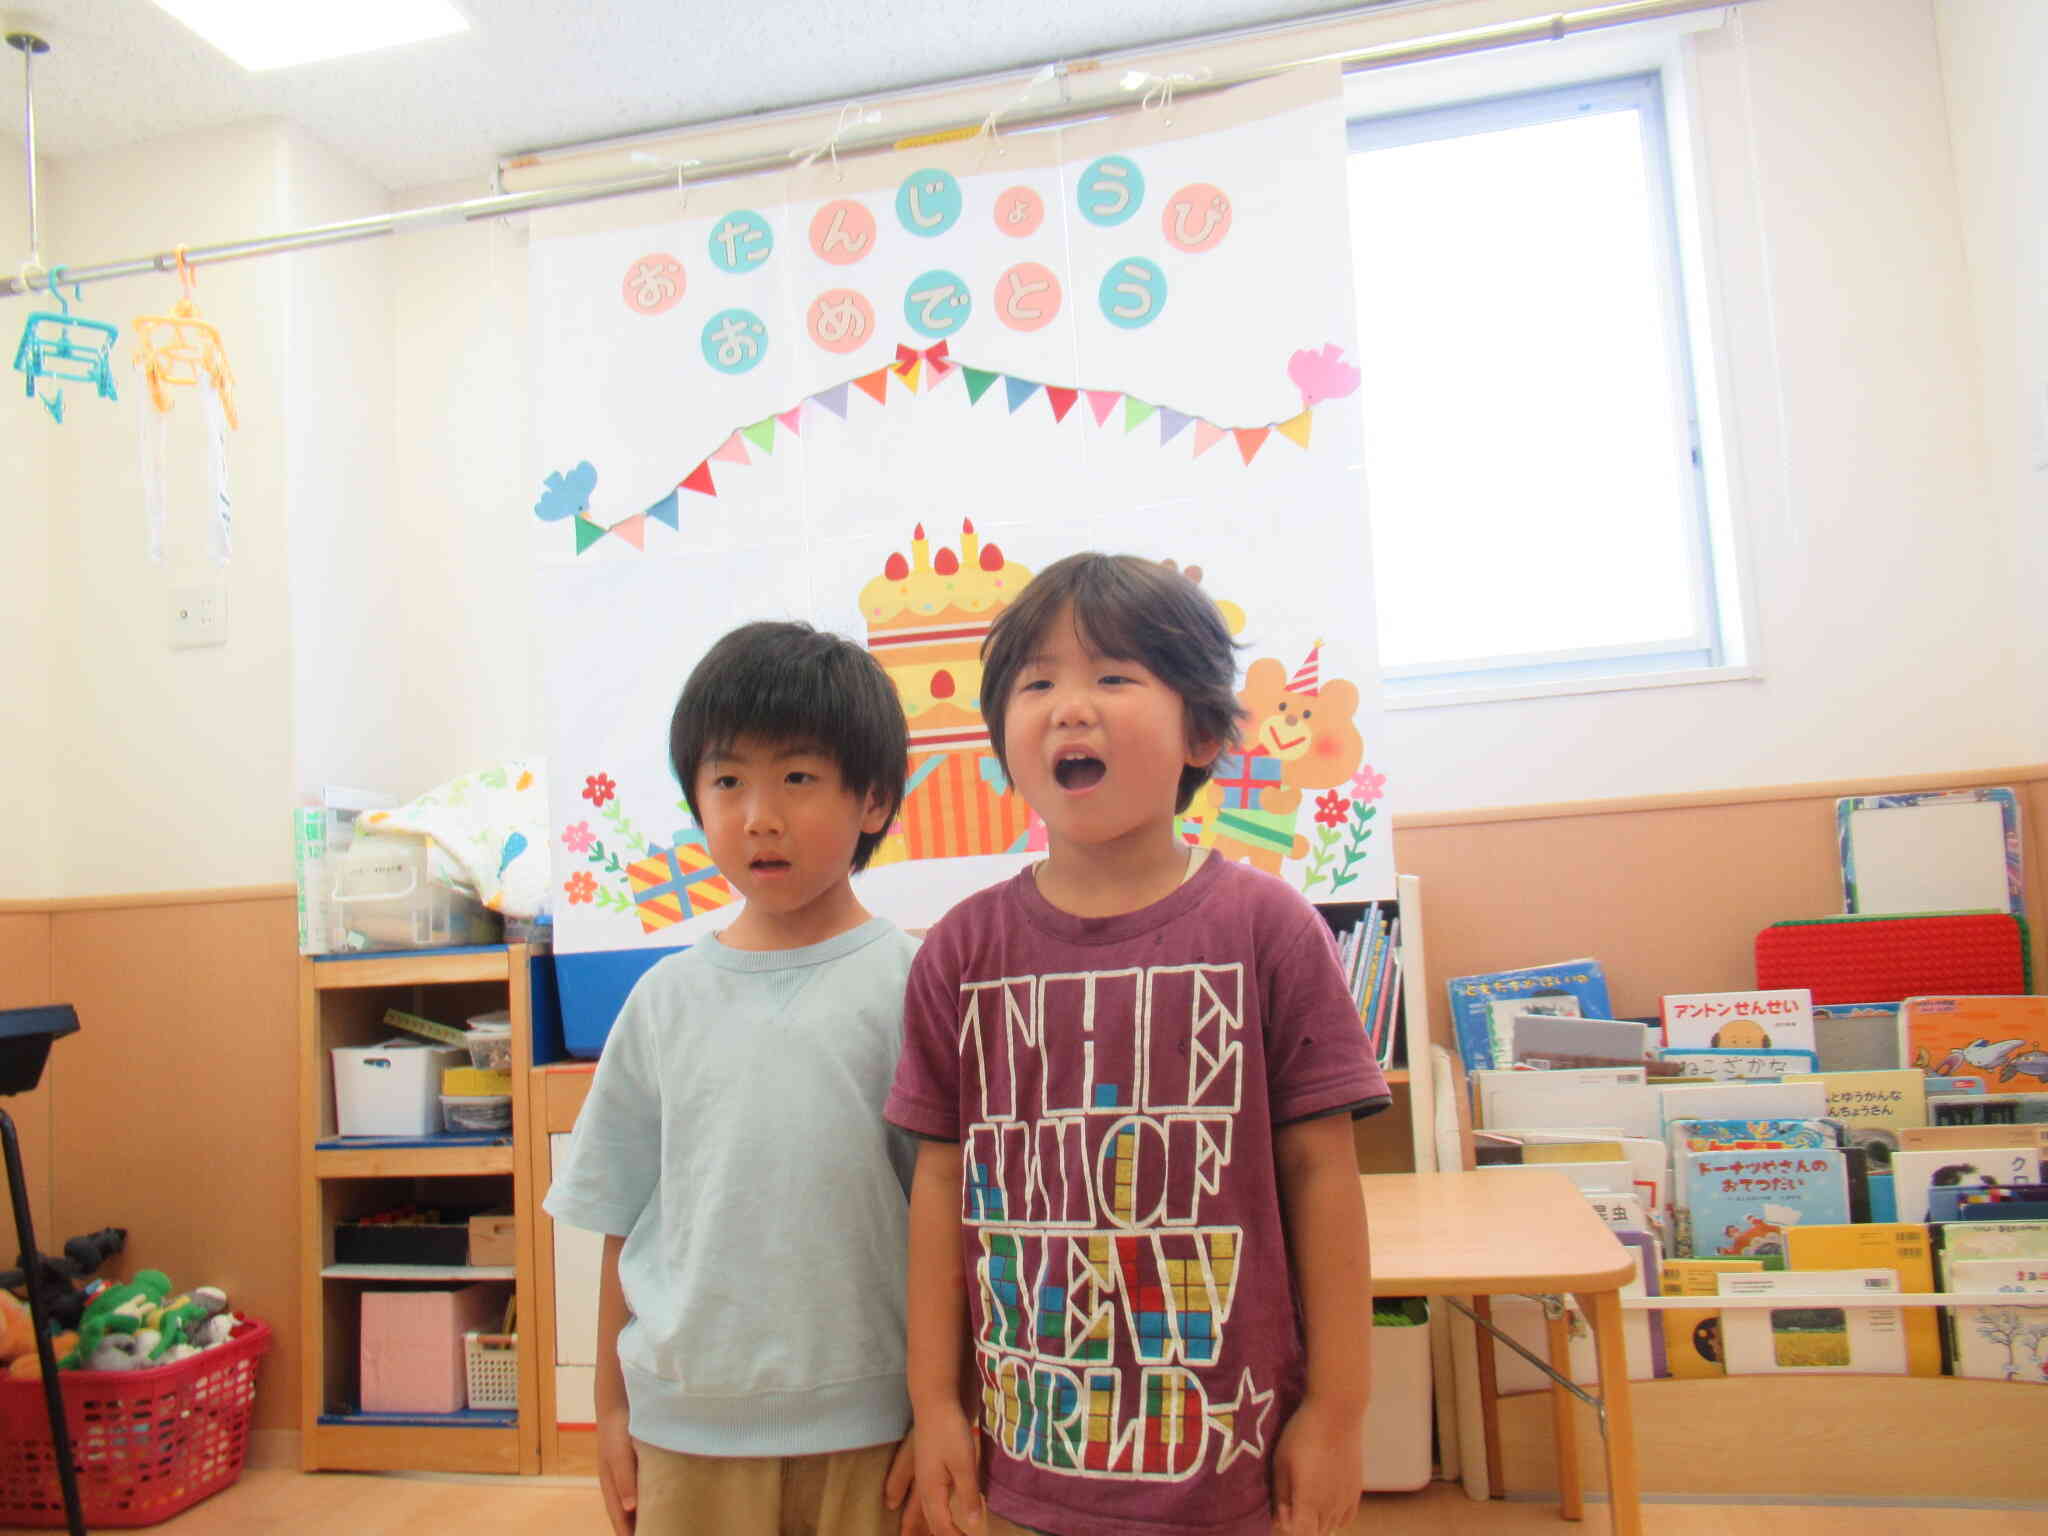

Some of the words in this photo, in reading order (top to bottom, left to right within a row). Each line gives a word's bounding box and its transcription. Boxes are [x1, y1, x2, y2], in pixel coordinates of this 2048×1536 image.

[627, 163, 1230, 307] おたんじょうび
[711, 264, 1153, 365] おめでとう
[959, 962, 1243, 1121] THE
[1673, 999, 1799, 1017] アントンせんせい
[1682, 1057, 1786, 1075] ねこざかな
[1096, 1114, 1233, 1229] OF
[1696, 1159, 1828, 1175] ドーナツやさんの
[1721, 1177, 1806, 1192] おてつだい
[976, 1226, 1243, 1365] NEW
